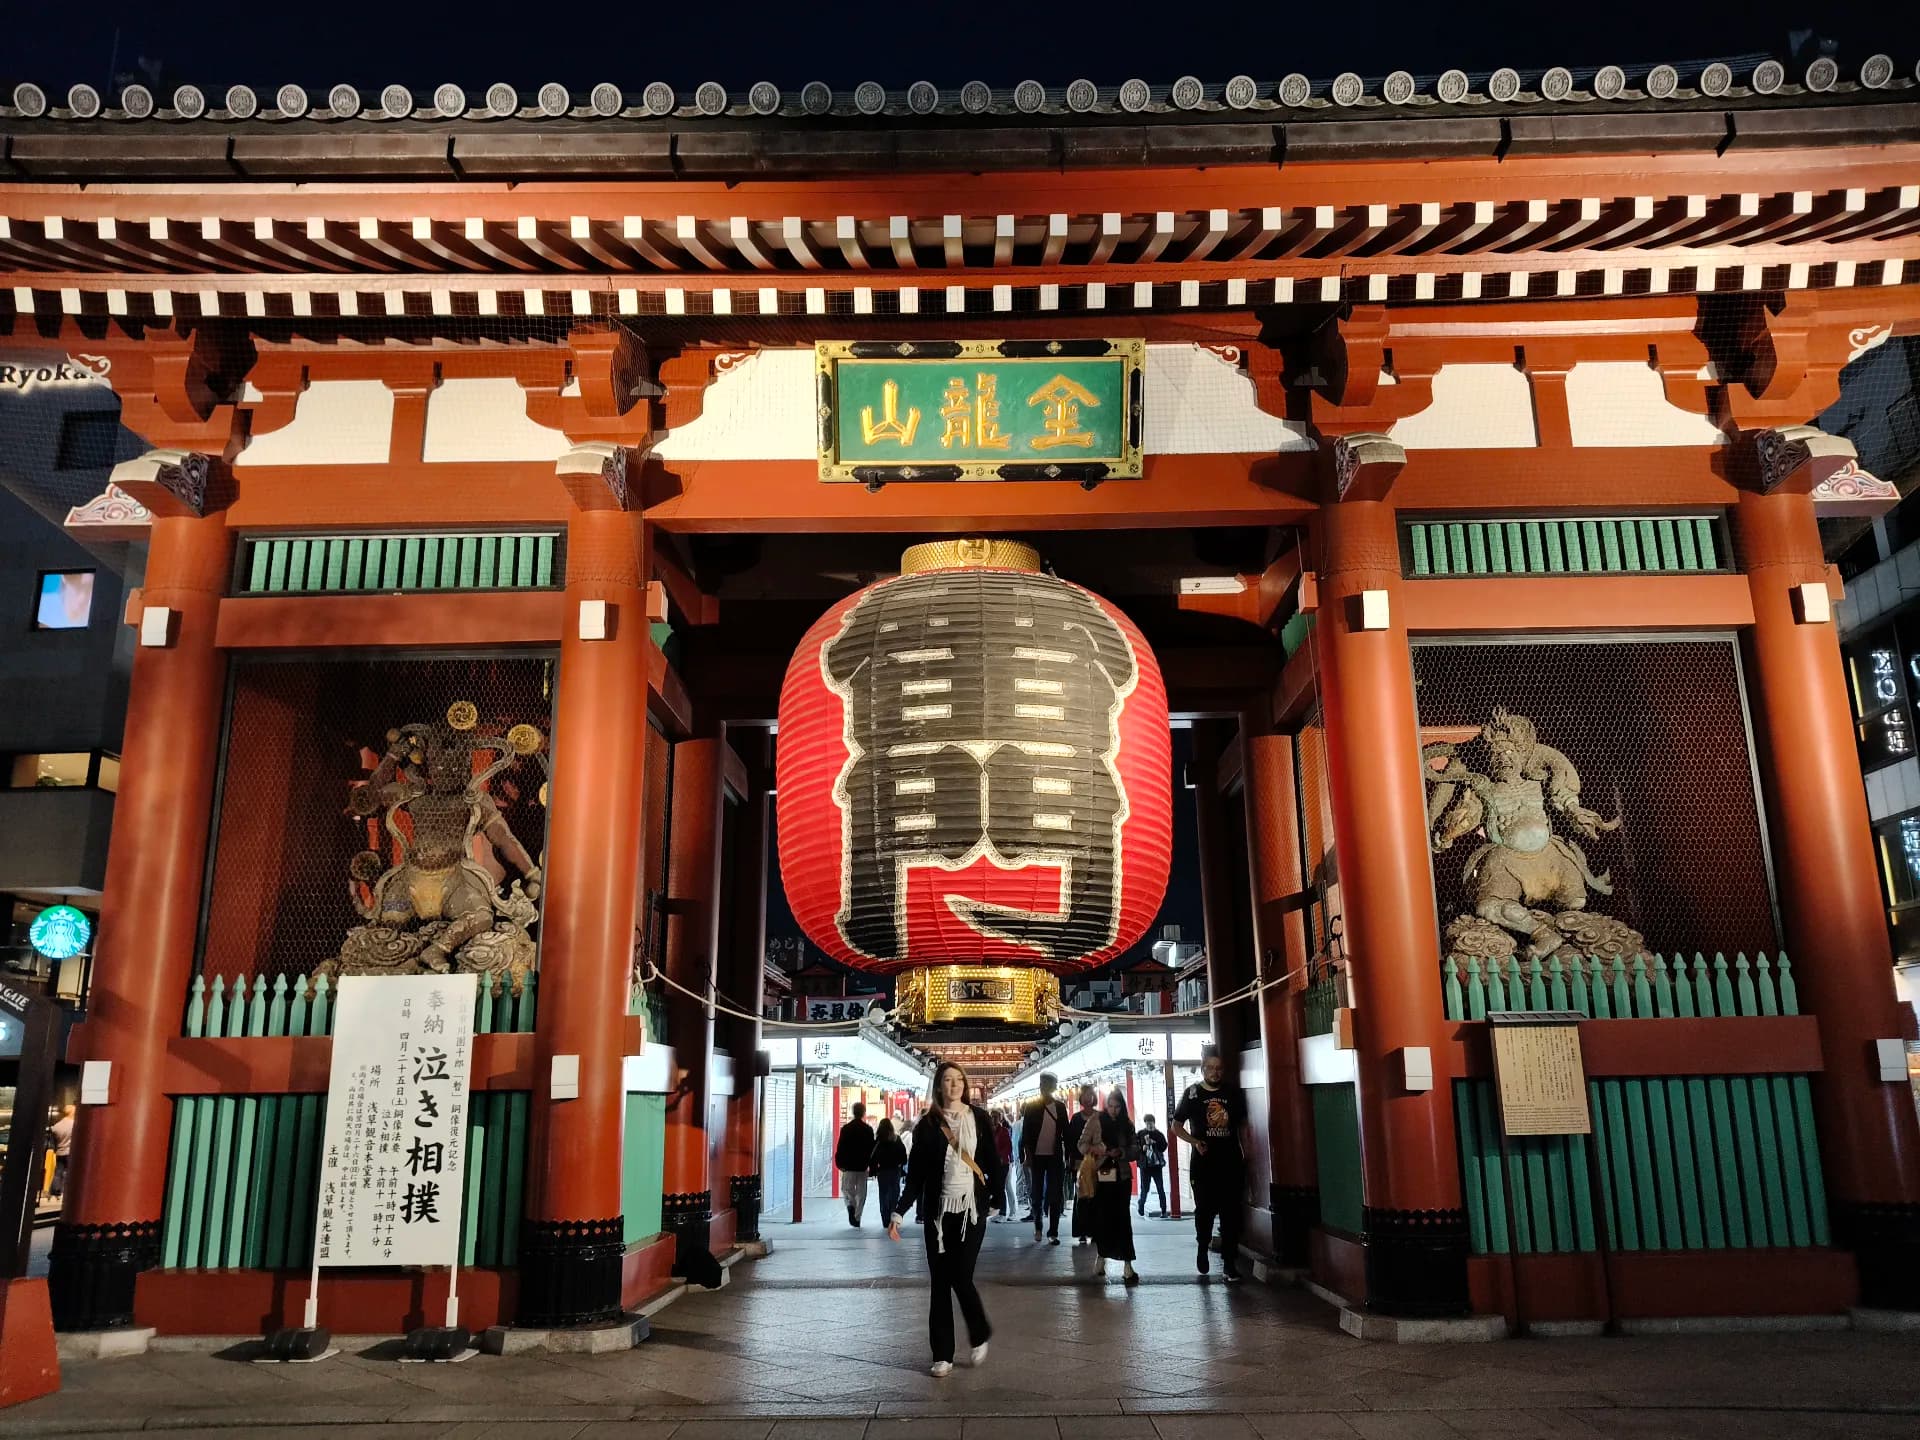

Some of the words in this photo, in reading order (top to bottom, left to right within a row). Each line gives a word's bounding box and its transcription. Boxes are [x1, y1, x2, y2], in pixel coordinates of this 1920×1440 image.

[0, 364, 94, 389] Ryoka
[4, 988, 30, 1007] GATE
[401, 998, 412, 1018] 日時
[424, 990, 445, 1034] 奉納
[951, 981, 1011, 1000] 松下電器
[370, 1064, 381, 1088] 場所
[362, 1101, 378, 1189] 浅草観音本堂裏
[379, 1109, 391, 1153] 泣き相撲
[400, 1046, 450, 1224] 泣き相撲
[328, 1145, 339, 1168] 主催
[320, 1181, 336, 1258] 浅草観光連盟
[372, 1166, 387, 1246] 午前十一時十分
[384, 1166, 399, 1258] 午前十時四十五分
